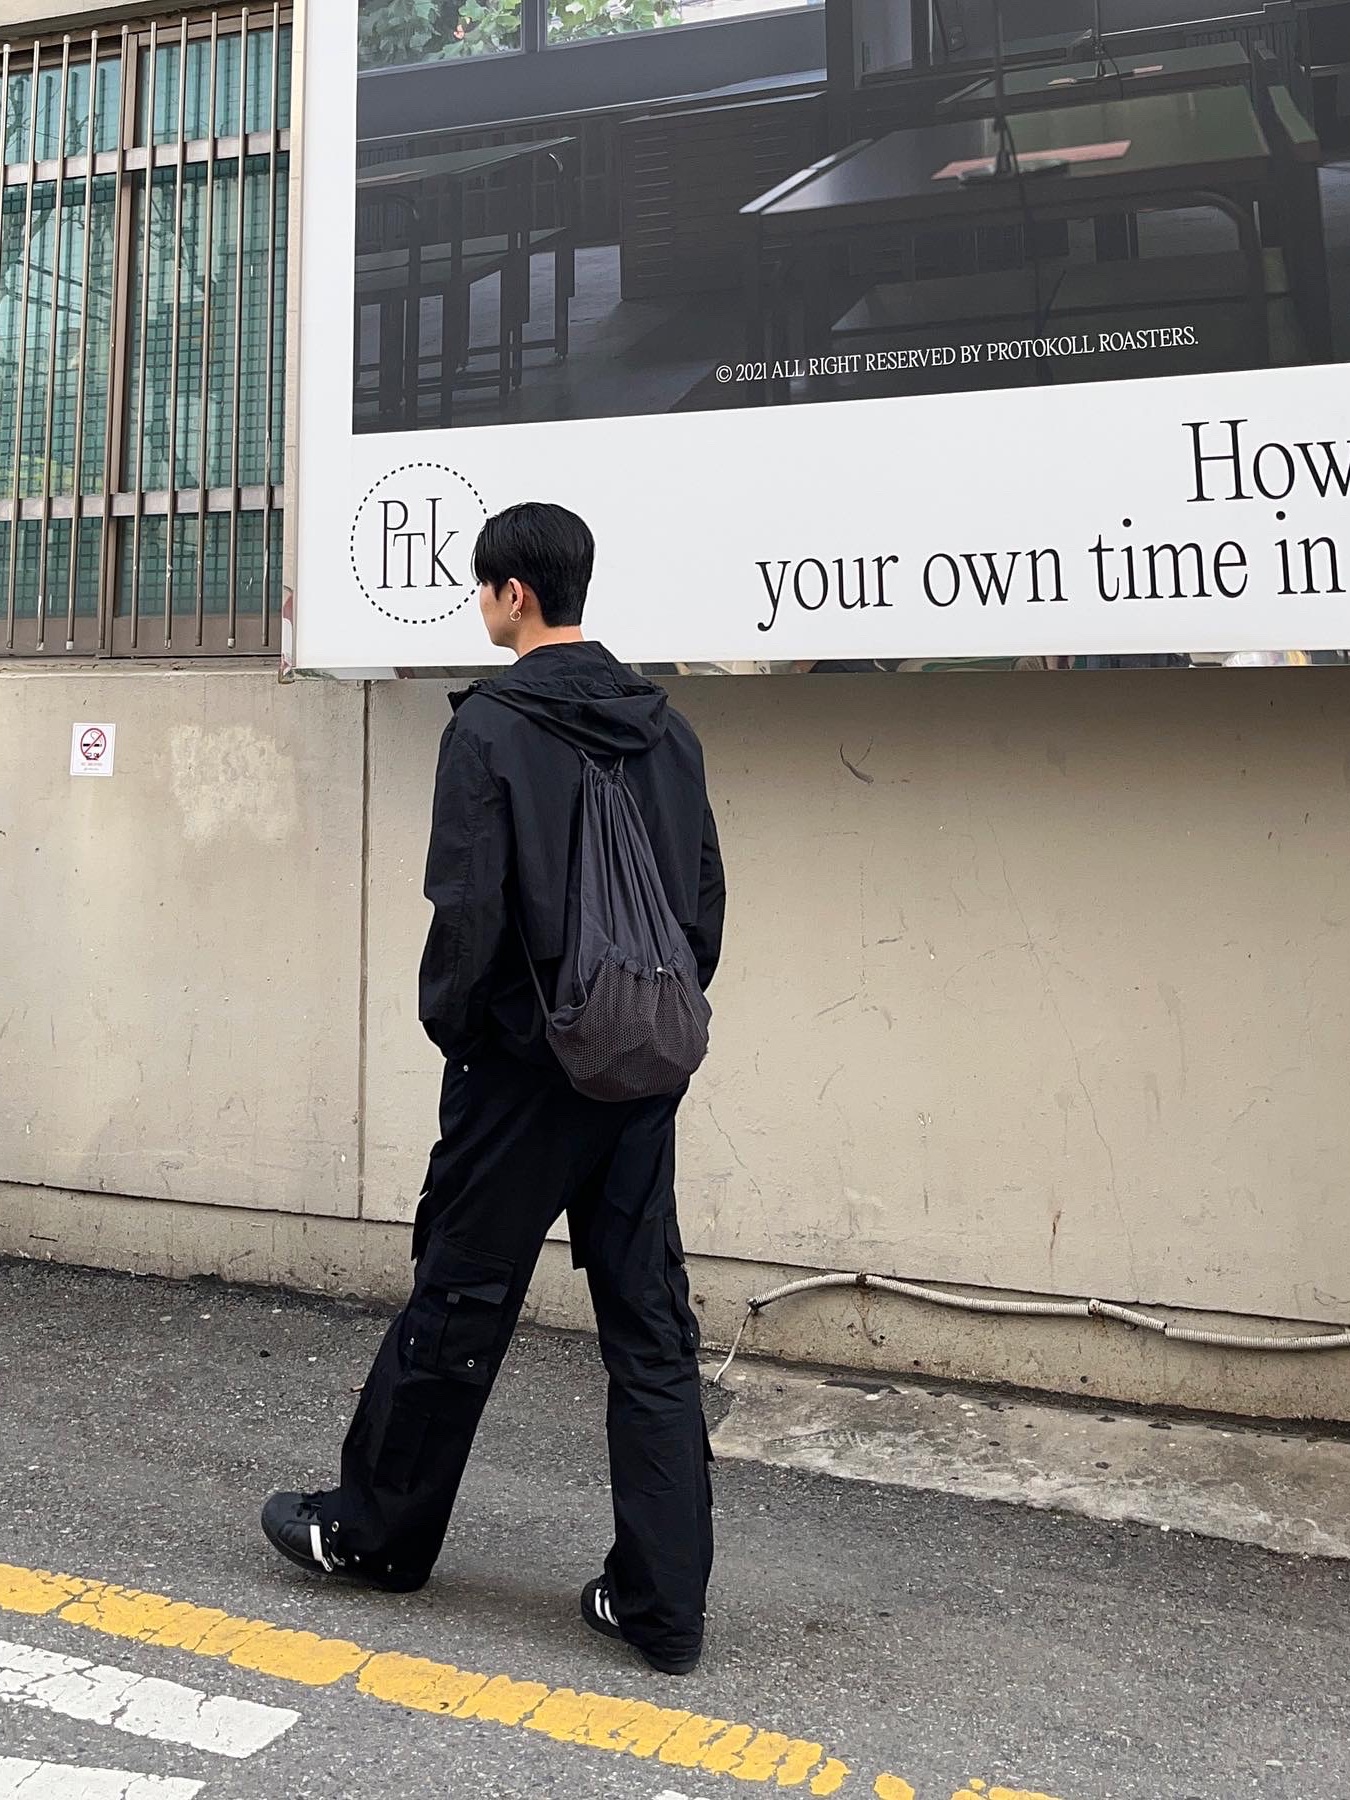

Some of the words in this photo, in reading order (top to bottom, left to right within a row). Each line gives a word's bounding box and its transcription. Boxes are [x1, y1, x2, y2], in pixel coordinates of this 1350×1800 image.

[735, 362, 767, 382] 2021
[771, 359, 806, 379] ALL
[808, 355, 862, 376] RIGHT
[865, 346, 956, 372] RESERVED
[960, 344, 983, 364] BY
[986, 336, 1095, 362] PROTOKOLL
[1098, 325, 1199, 353] ROASTERS.
[1181, 418, 1350, 503] How
[754, 554, 899, 632] your
[923, 548, 1069, 608] own
[1087, 517, 1248, 602] time
[1274, 510, 1347, 595] in
